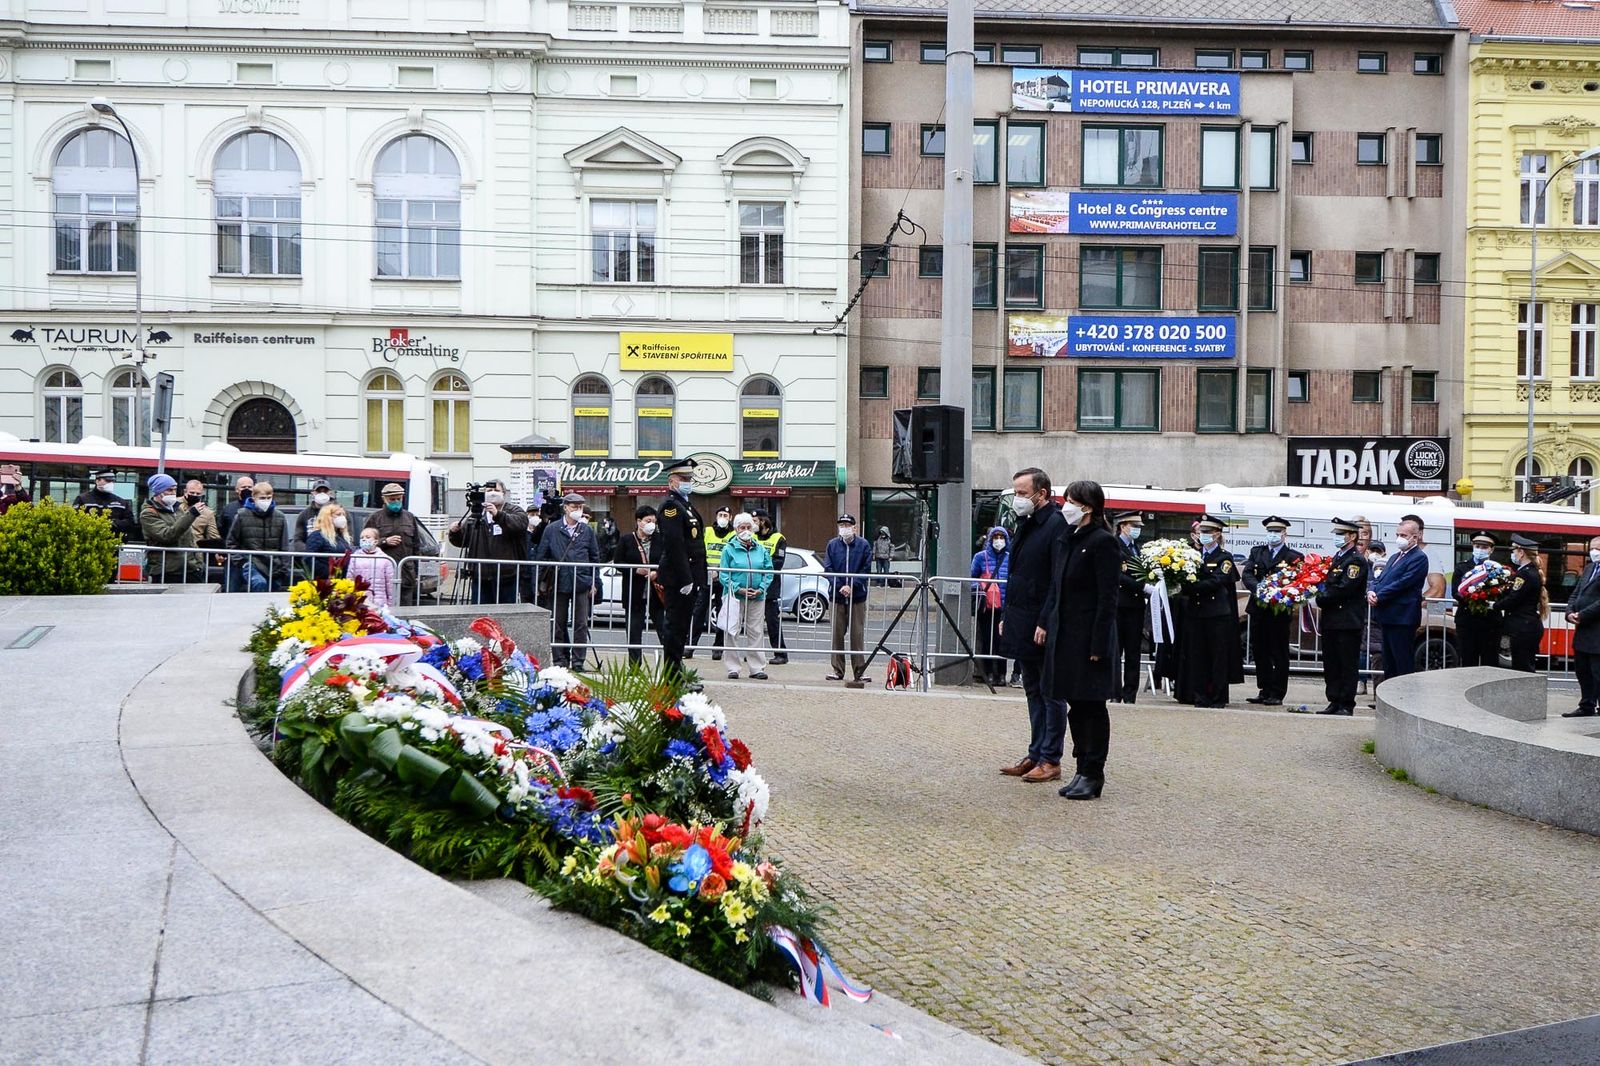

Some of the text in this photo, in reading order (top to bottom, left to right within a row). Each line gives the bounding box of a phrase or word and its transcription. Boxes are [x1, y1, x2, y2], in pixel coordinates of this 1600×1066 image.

[1079, 80, 1231, 96] HOTEL PRIMAVERA
[1079, 98, 1231, 110] NEPOMUCKÁ 128, PLZEŇ 4 km
[1077, 203, 1228, 218] Hotel & Congress centre
[1089, 220, 1217, 230] WWW.PRIMAVERAHOTEL.CZ
[41, 328, 139, 344] TAURUM
[193, 332, 315, 345] Raiffeisen centrum
[1075, 325, 1227, 340] +420 378 020 500
[372, 333, 422, 353] Broker
[1075, 342, 1226, 353] UBYTOVÁNÍ KONFERENCE SVATBY
[383, 343, 460, 362] Consulting
[680, 352, 728, 360] SPOŘITELNA
[1296, 441, 1401, 485] TABÁK
[1413, 459, 1438, 467] STRIKE
[1415, 451, 1438, 460] LUCKY
[758, 461, 818, 486] upekla!
